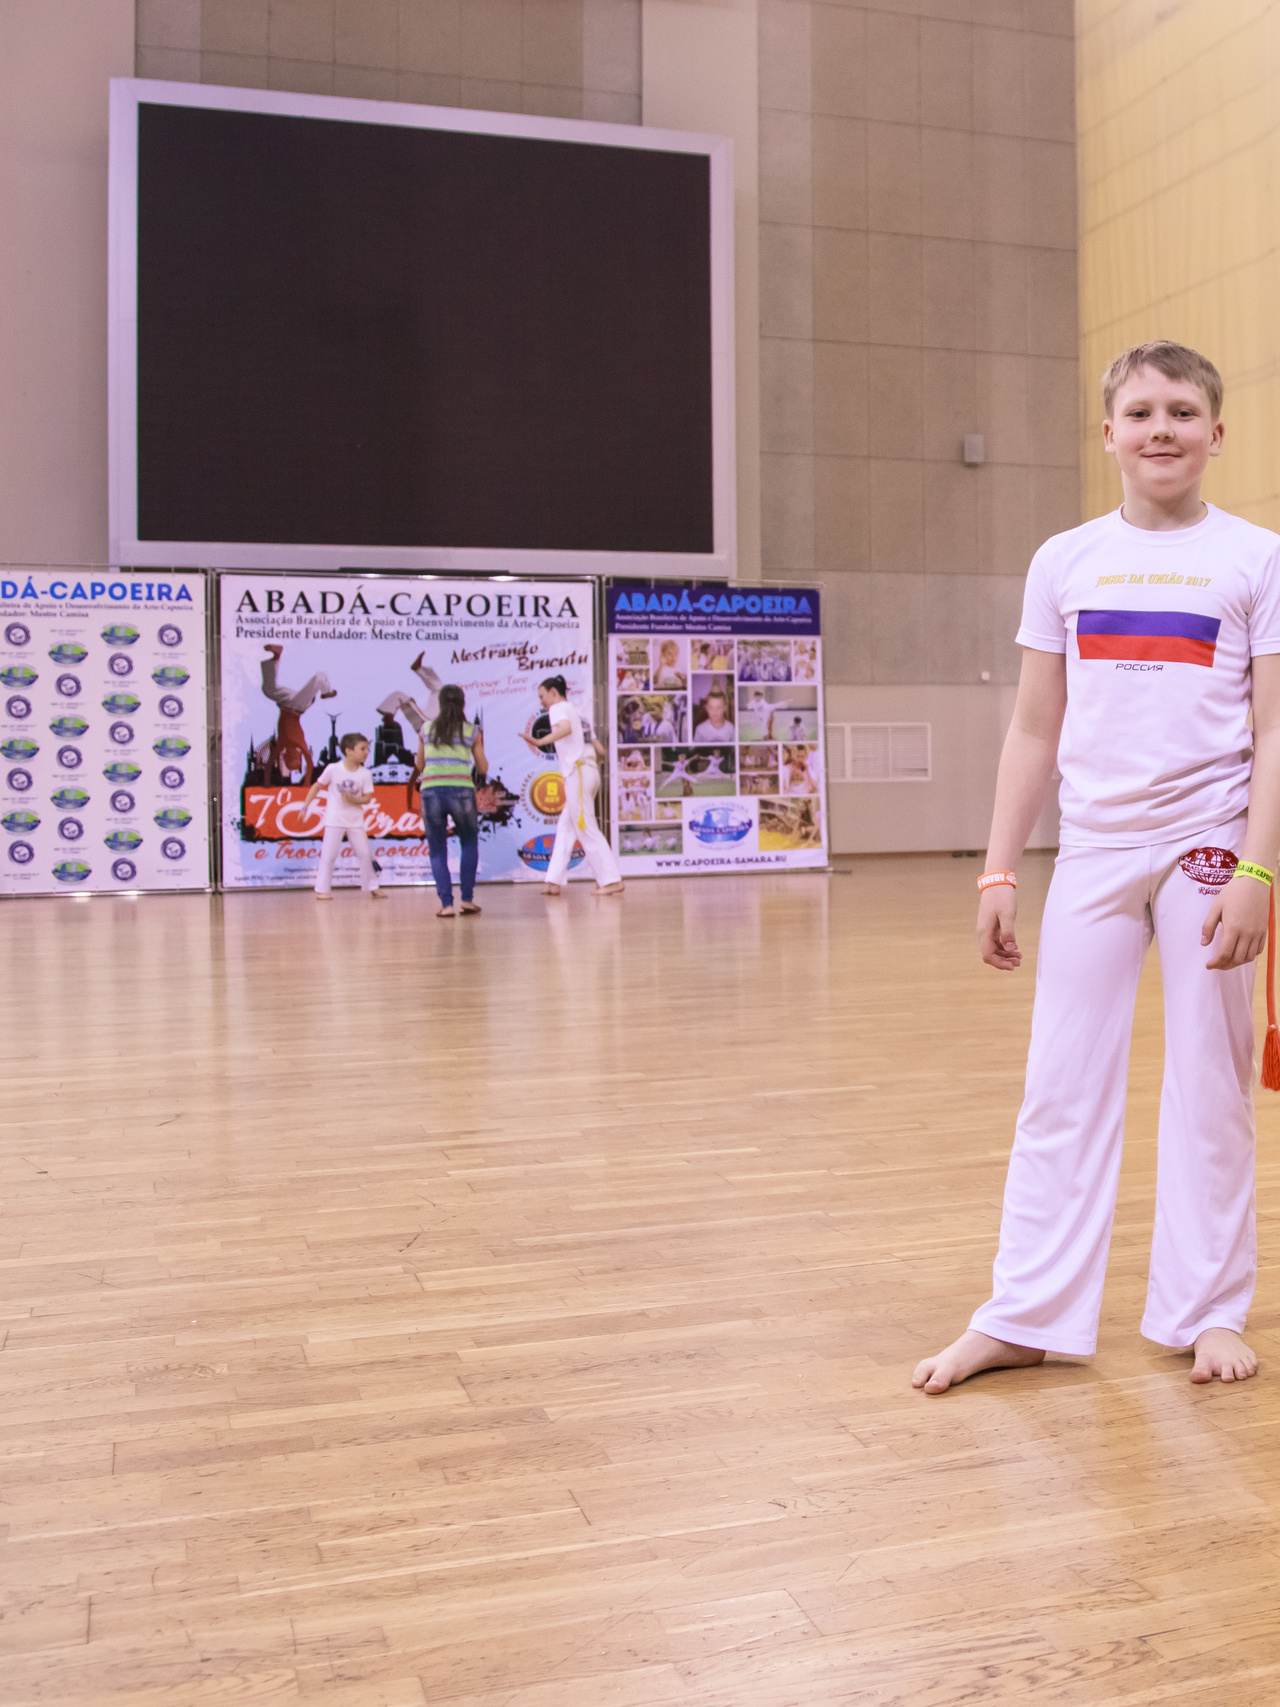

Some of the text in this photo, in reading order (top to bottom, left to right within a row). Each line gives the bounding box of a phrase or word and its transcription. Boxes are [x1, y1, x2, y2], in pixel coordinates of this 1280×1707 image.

[1095, 572, 1211, 588] JOGOS DA UNIÃO 2017
[236, 584, 579, 617] ABADÁ-CAPOEIRA
[614, 589, 812, 614] ABADÁ-CAPOEIRA
[236, 615, 293, 626] Associação
[296, 616, 346, 626] Brasileira
[350, 617, 361, 626] de
[365, 617, 395, 629] Apoio
[406, 617, 495, 629] Desenvolvimento
[497, 618, 509, 628] da
[512, 619, 580, 631] Arte-Capoeira
[236, 626, 459, 641] Presidente Fundador: Mestre Camisa
[450, 640, 538, 664] Mestrando
[516, 650, 588, 671] Brucutu
[1115, 663, 1164, 672] РОССИЯ
[656, 855, 787, 867] WWW.CAPOEIRA-SAMARA.RU
